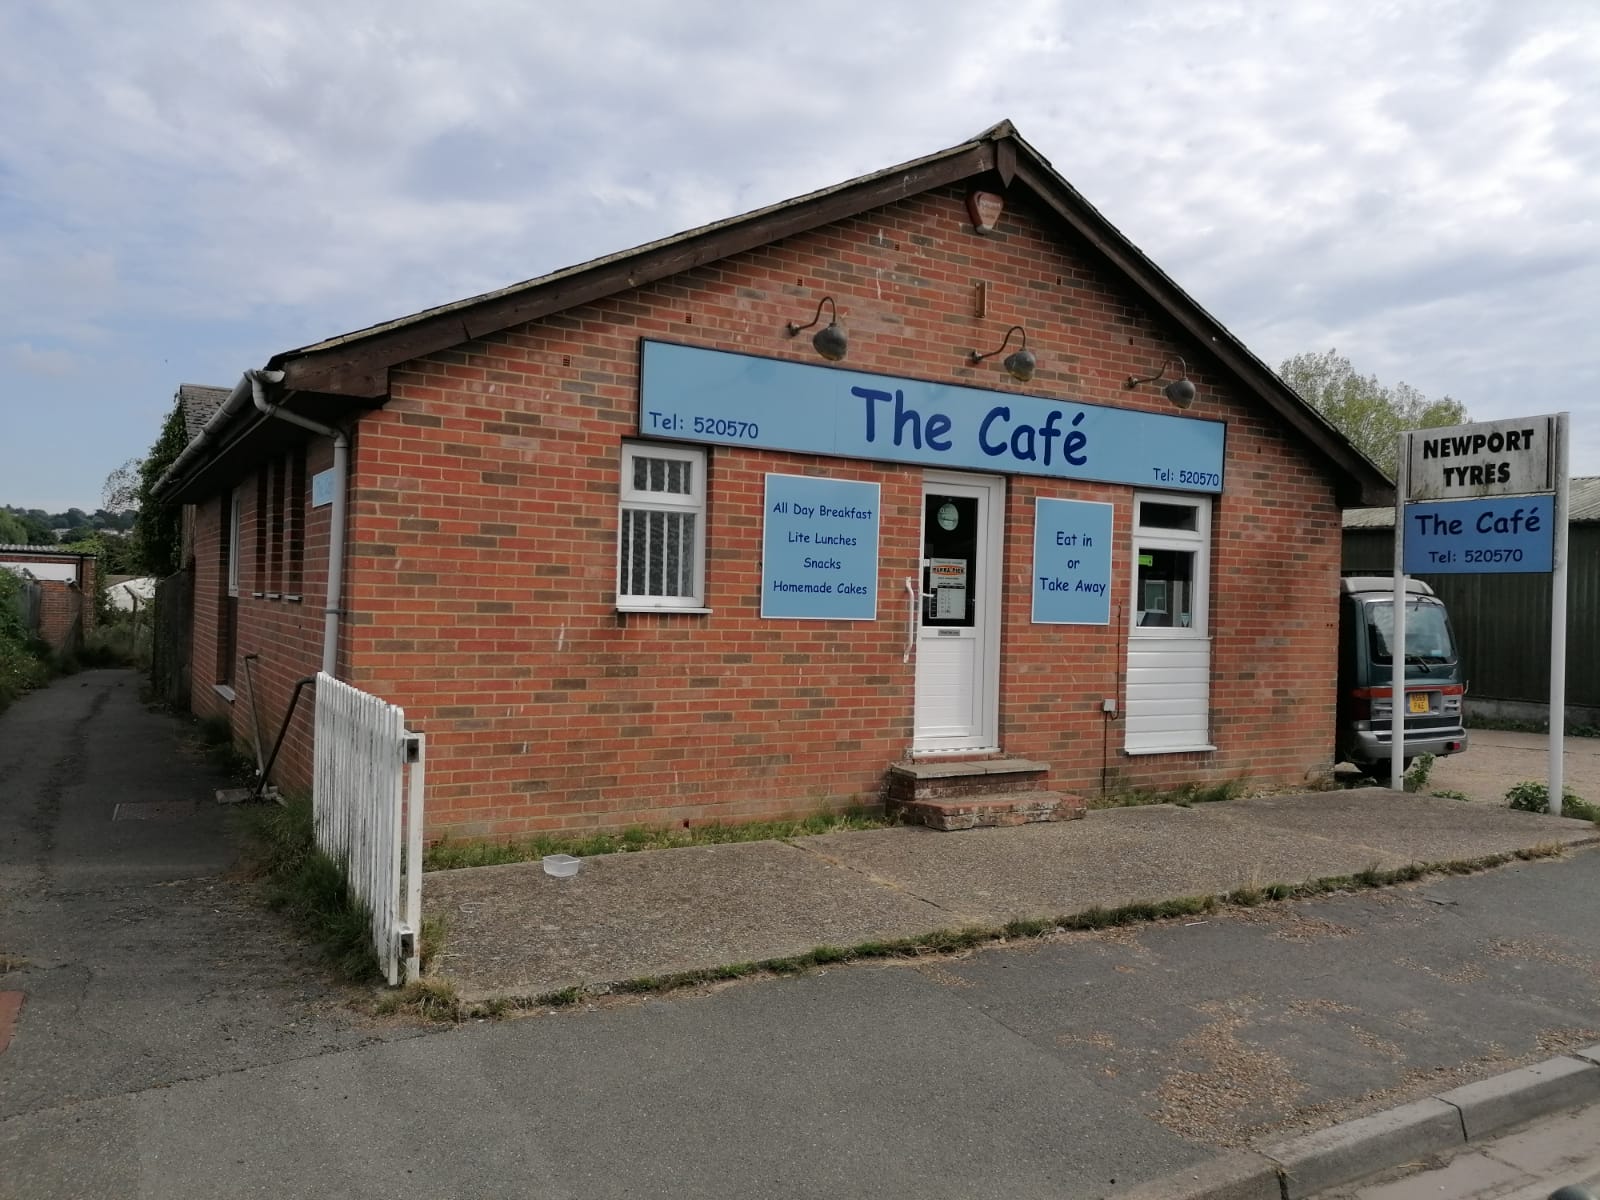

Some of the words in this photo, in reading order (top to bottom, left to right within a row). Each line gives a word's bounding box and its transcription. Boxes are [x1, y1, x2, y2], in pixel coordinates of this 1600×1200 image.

[649, 411, 684, 430] Tel:
[694, 416, 759, 439] 520570
[851, 386, 952, 451] The
[978, 406, 1088, 466] Café
[1423, 429, 1534, 460] NEWPORT
[1153, 467, 1174, 482] Tel:
[1179, 470, 1219, 487] 520570
[1443, 462, 1511, 487] TYRES
[773, 502, 788, 514] All
[793, 503, 815, 518] Day
[819, 505, 872, 519] Breakfast
[1414, 513, 1463, 535] The
[1476, 507, 1541, 535] Café
[788, 531, 810, 543] Lite
[815, 532, 857, 546] Lunches
[1056, 531, 1078, 546] Eat
[1082, 534, 1093, 547] in
[803, 557, 841, 569] Snacks
[1067, 559, 1080, 569] or
[1428, 550, 1457, 563] Tel:
[1464, 549, 1524, 563] 520570
[773, 580, 832, 594] Homemade
[836, 582, 868, 595] Cakes
[1039, 577, 1070, 592] Take
[1074, 579, 1106, 597] Away
